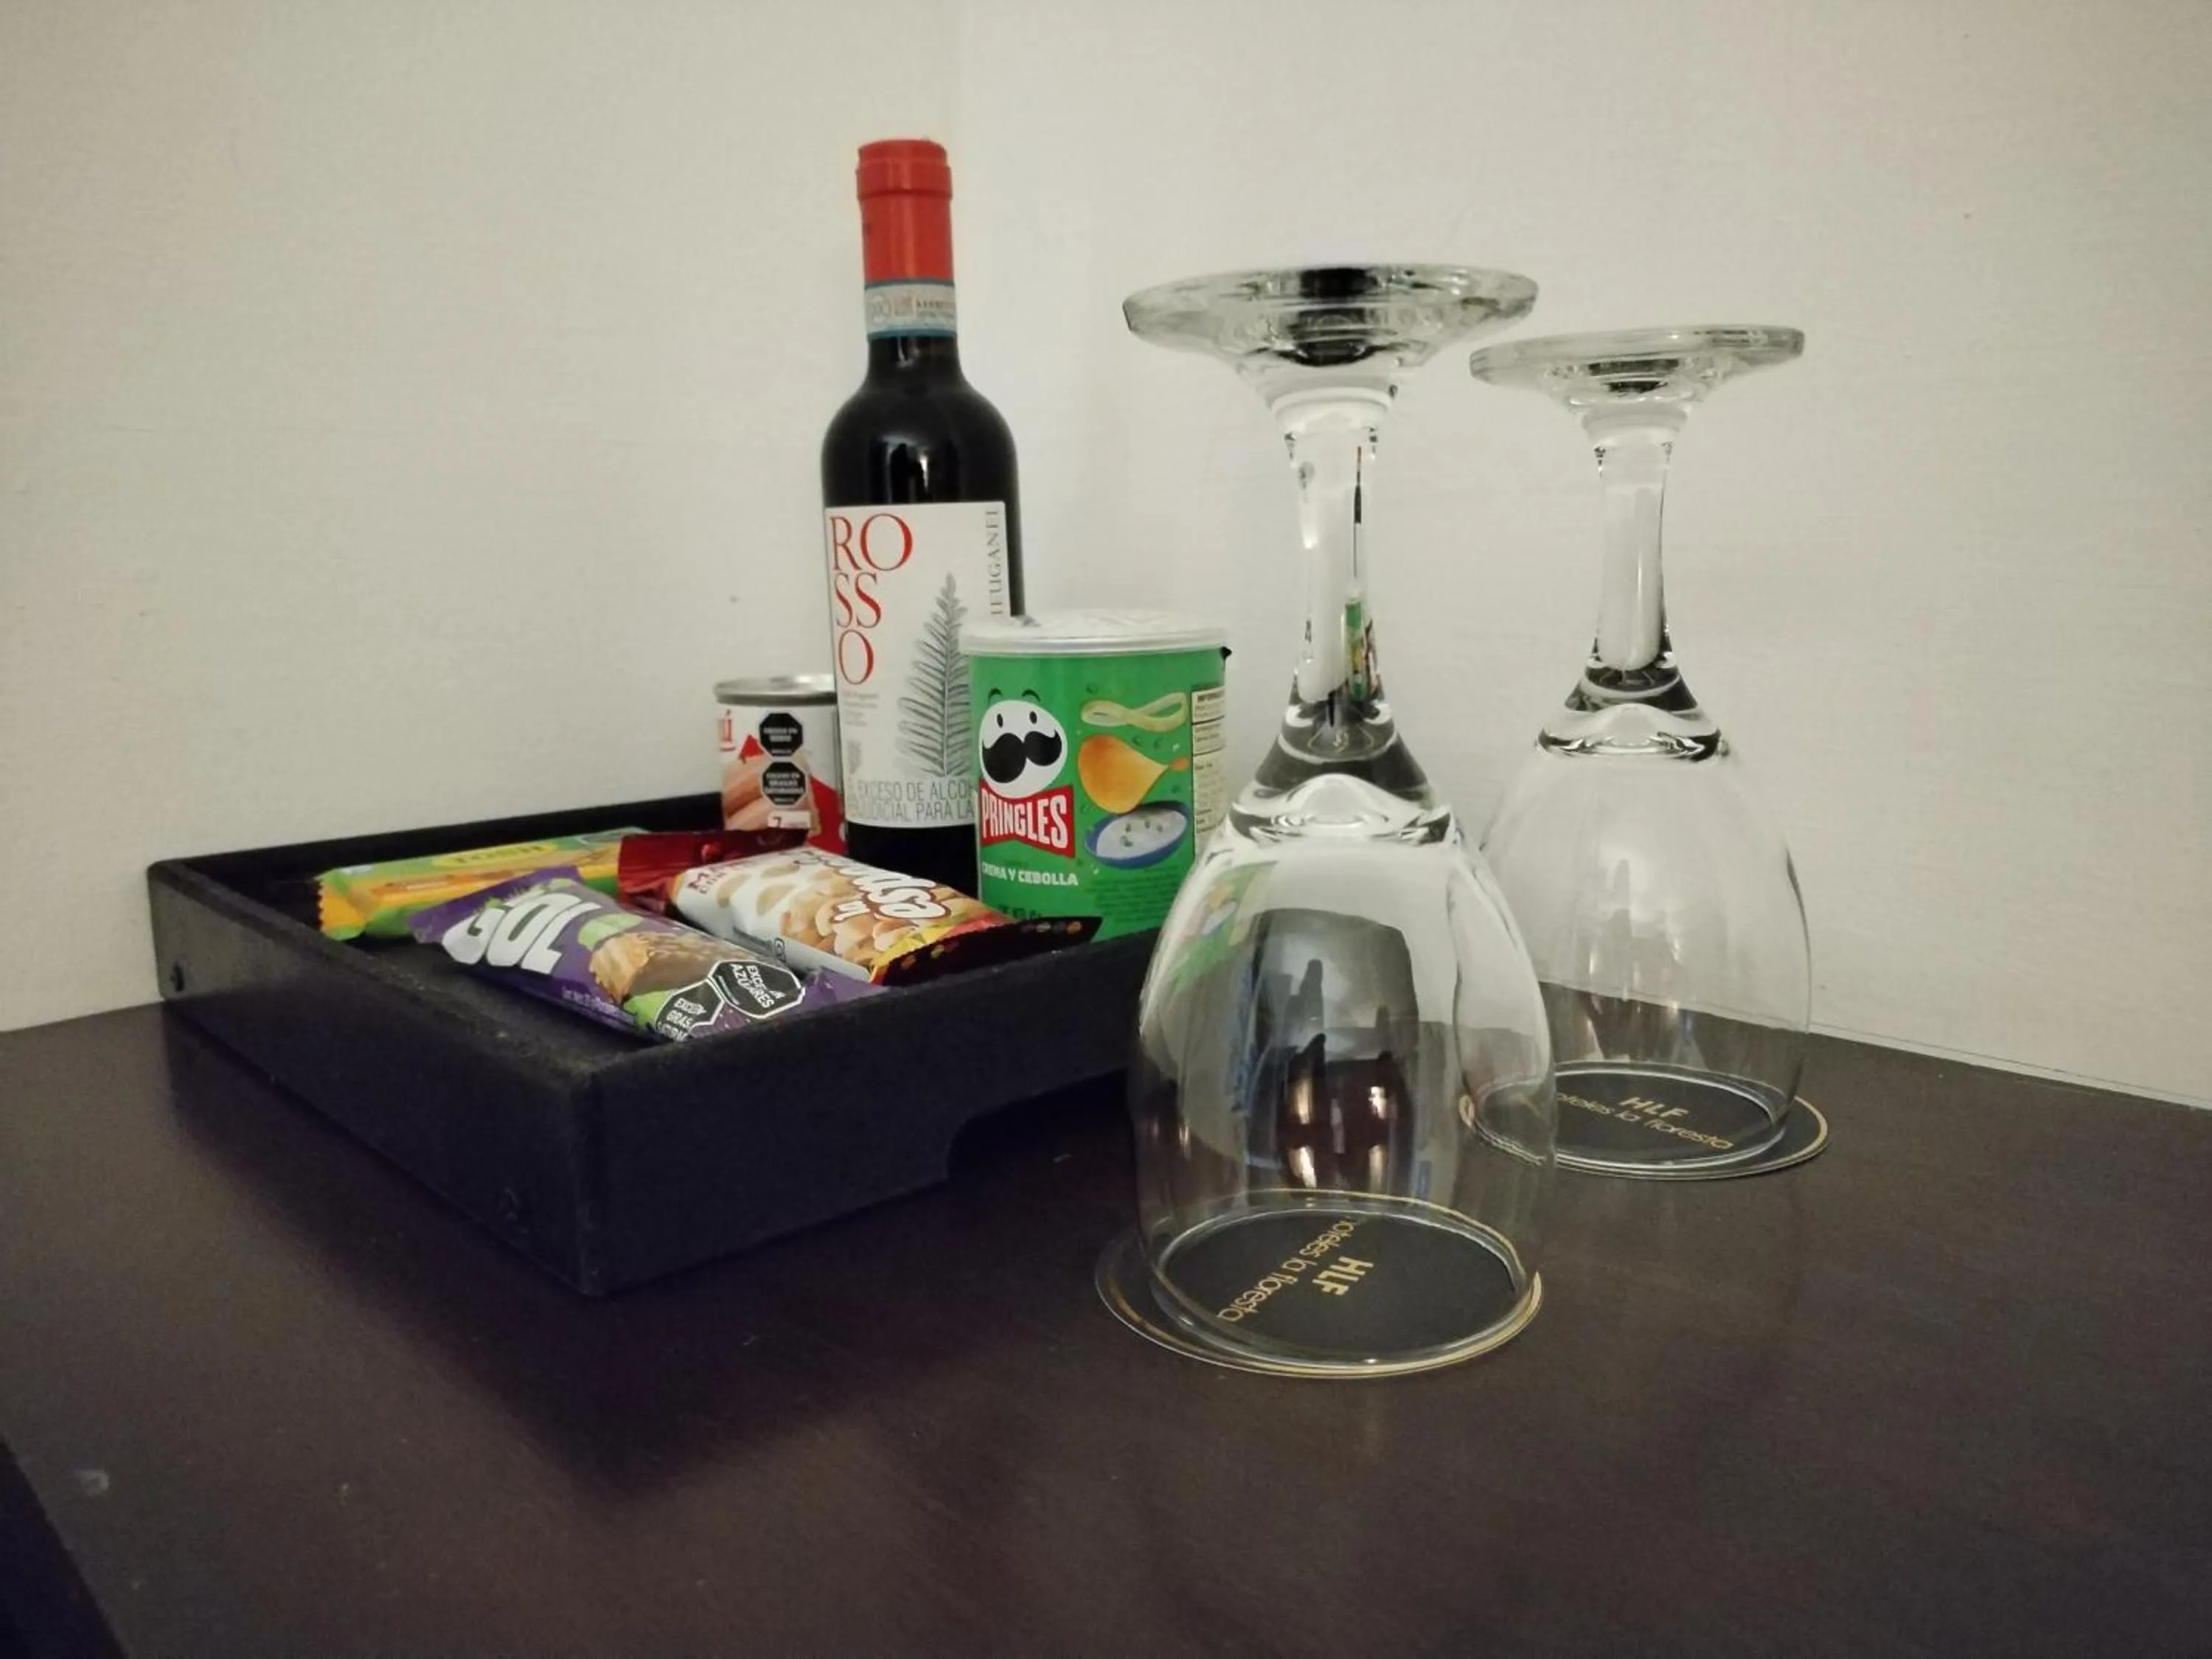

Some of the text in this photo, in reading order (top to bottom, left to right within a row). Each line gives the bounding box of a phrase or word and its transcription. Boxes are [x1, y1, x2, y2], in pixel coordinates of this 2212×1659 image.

[906, 782, 925, 801] DE
[931, 778, 974, 801] ALCO
[916, 801, 953, 821] PARA
[957, 799, 975, 819] LA
[981, 787, 1068, 849] PRINGLES
[1008, 869, 1016, 882] Y
[1018, 870, 1079, 886] CEBOLLA
[442, 892, 602, 974] GOL
[1618, 1096, 1690, 1117] HLF
[1312, 1256, 1375, 1296] HLF
